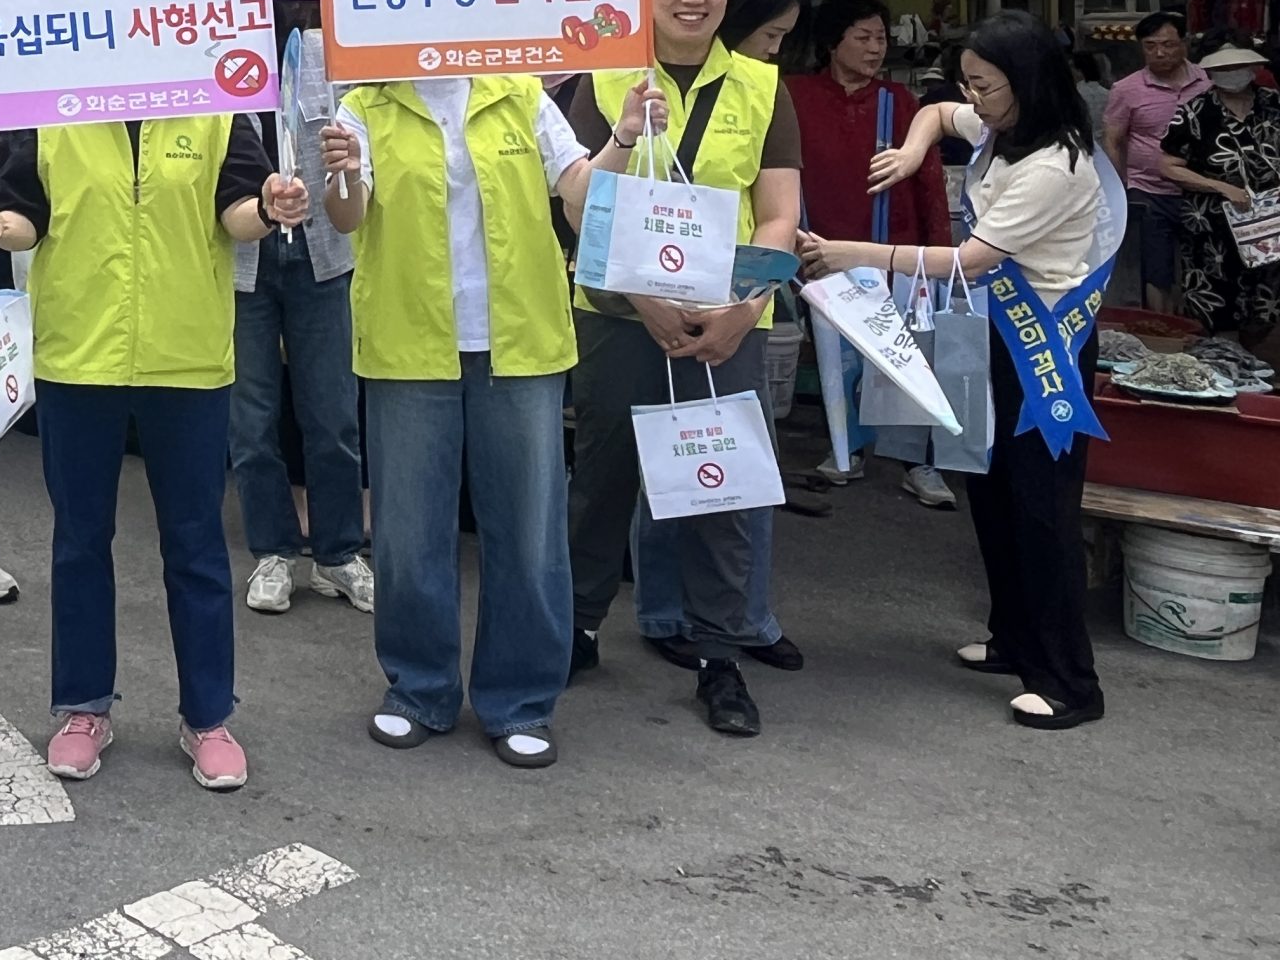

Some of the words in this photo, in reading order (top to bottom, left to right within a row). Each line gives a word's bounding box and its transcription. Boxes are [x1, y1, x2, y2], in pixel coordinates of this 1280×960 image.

[445, 45, 564, 68] 화순군보건소
[85, 88, 212, 115] 화순군보건소
[643, 216, 675, 235] 치료는
[679, 221, 703, 238] 금연
[990, 276, 1019, 303] 한
[1028, 348, 1065, 398] 검사
